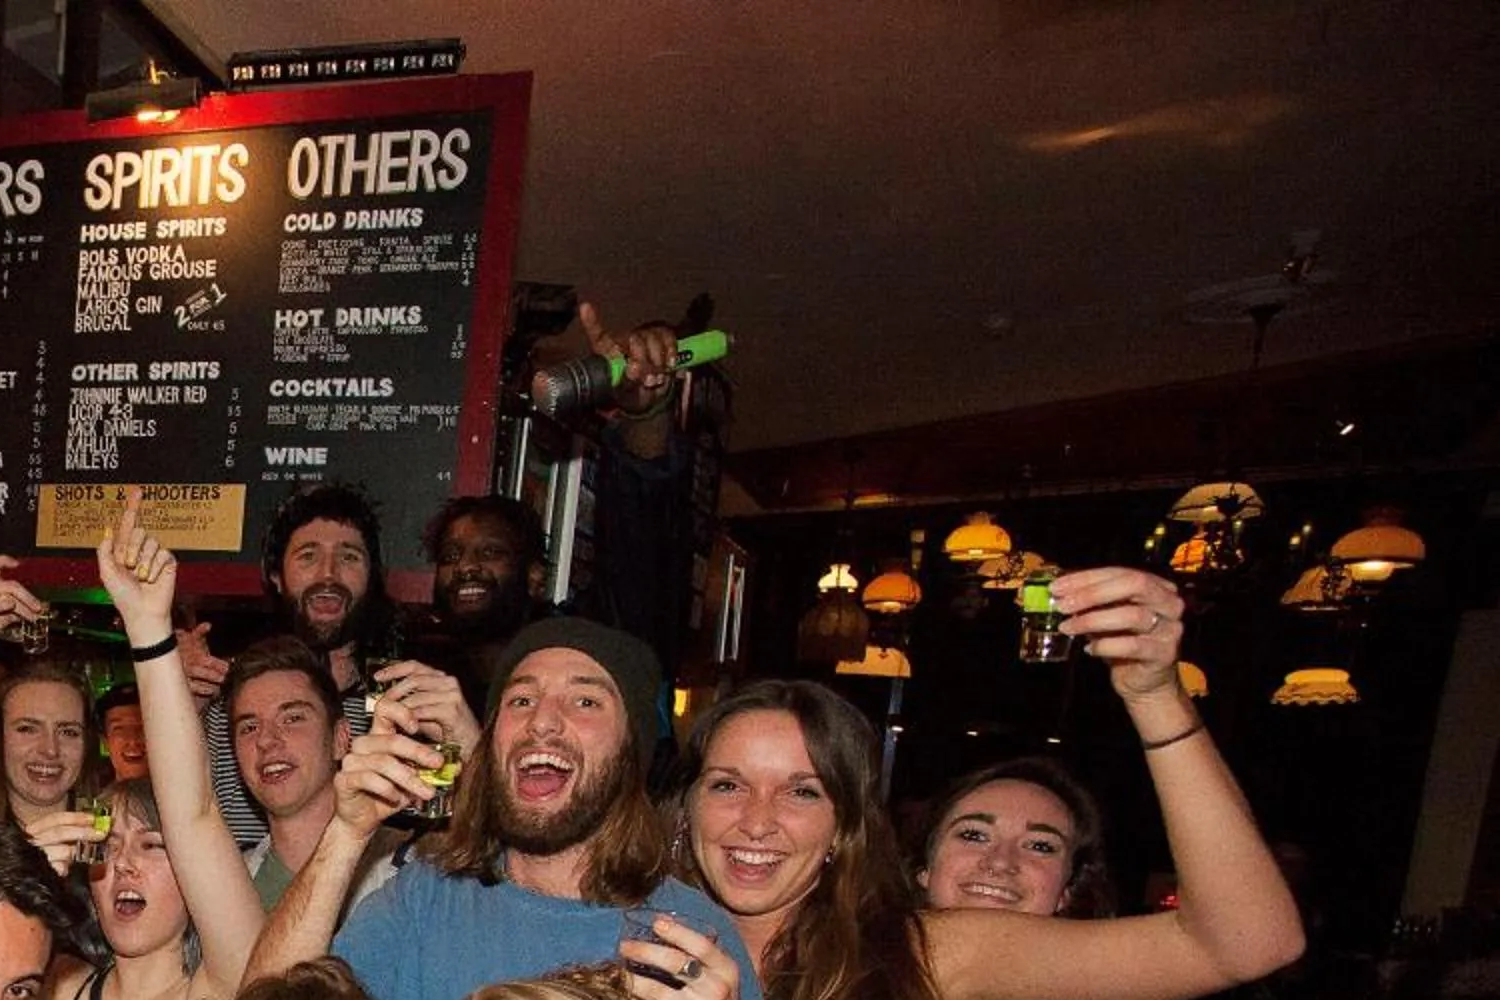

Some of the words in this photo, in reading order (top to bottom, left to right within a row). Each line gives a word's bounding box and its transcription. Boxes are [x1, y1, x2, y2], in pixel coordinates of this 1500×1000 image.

[287, 127, 471, 200] OTHERS
[83, 143, 249, 211] SPIRITS
[284, 210, 336, 232] COLD
[343, 207, 424, 230] DRINKS
[80, 222, 147, 243] HOUSE
[156, 217, 227, 239] SPIRITS
[79, 247, 119, 266] BOLS
[126, 244, 186, 264] VODKA
[78, 263, 143, 282] FAMOUS
[150, 259, 217, 280] GROUSE
[77, 282, 131, 300] MALIBU
[75, 299, 129, 316] LARIOS
[135, 296, 163, 314] GIN
[74, 315, 132, 333] BRUGAL
[174, 305, 191, 328] 2
[275, 308, 324, 328] HOT
[335, 305, 422, 326] DRINKS
[71, 362, 139, 382] OTHER
[149, 361, 221, 381] SPIRITS
[127, 385, 179, 404] WALKER
[183, 385, 207, 404] RED
[269, 377, 395, 397] COCKTAILS
[69, 404, 103, 421] LICOR
[67, 421, 97, 437] JACK
[103, 419, 157, 437] DANIELS
[65, 453, 119, 470] BAILEYS
[263, 446, 328, 465] WINE
[55, 485, 104, 501] SHOTS
[116, 486, 126, 500] &
